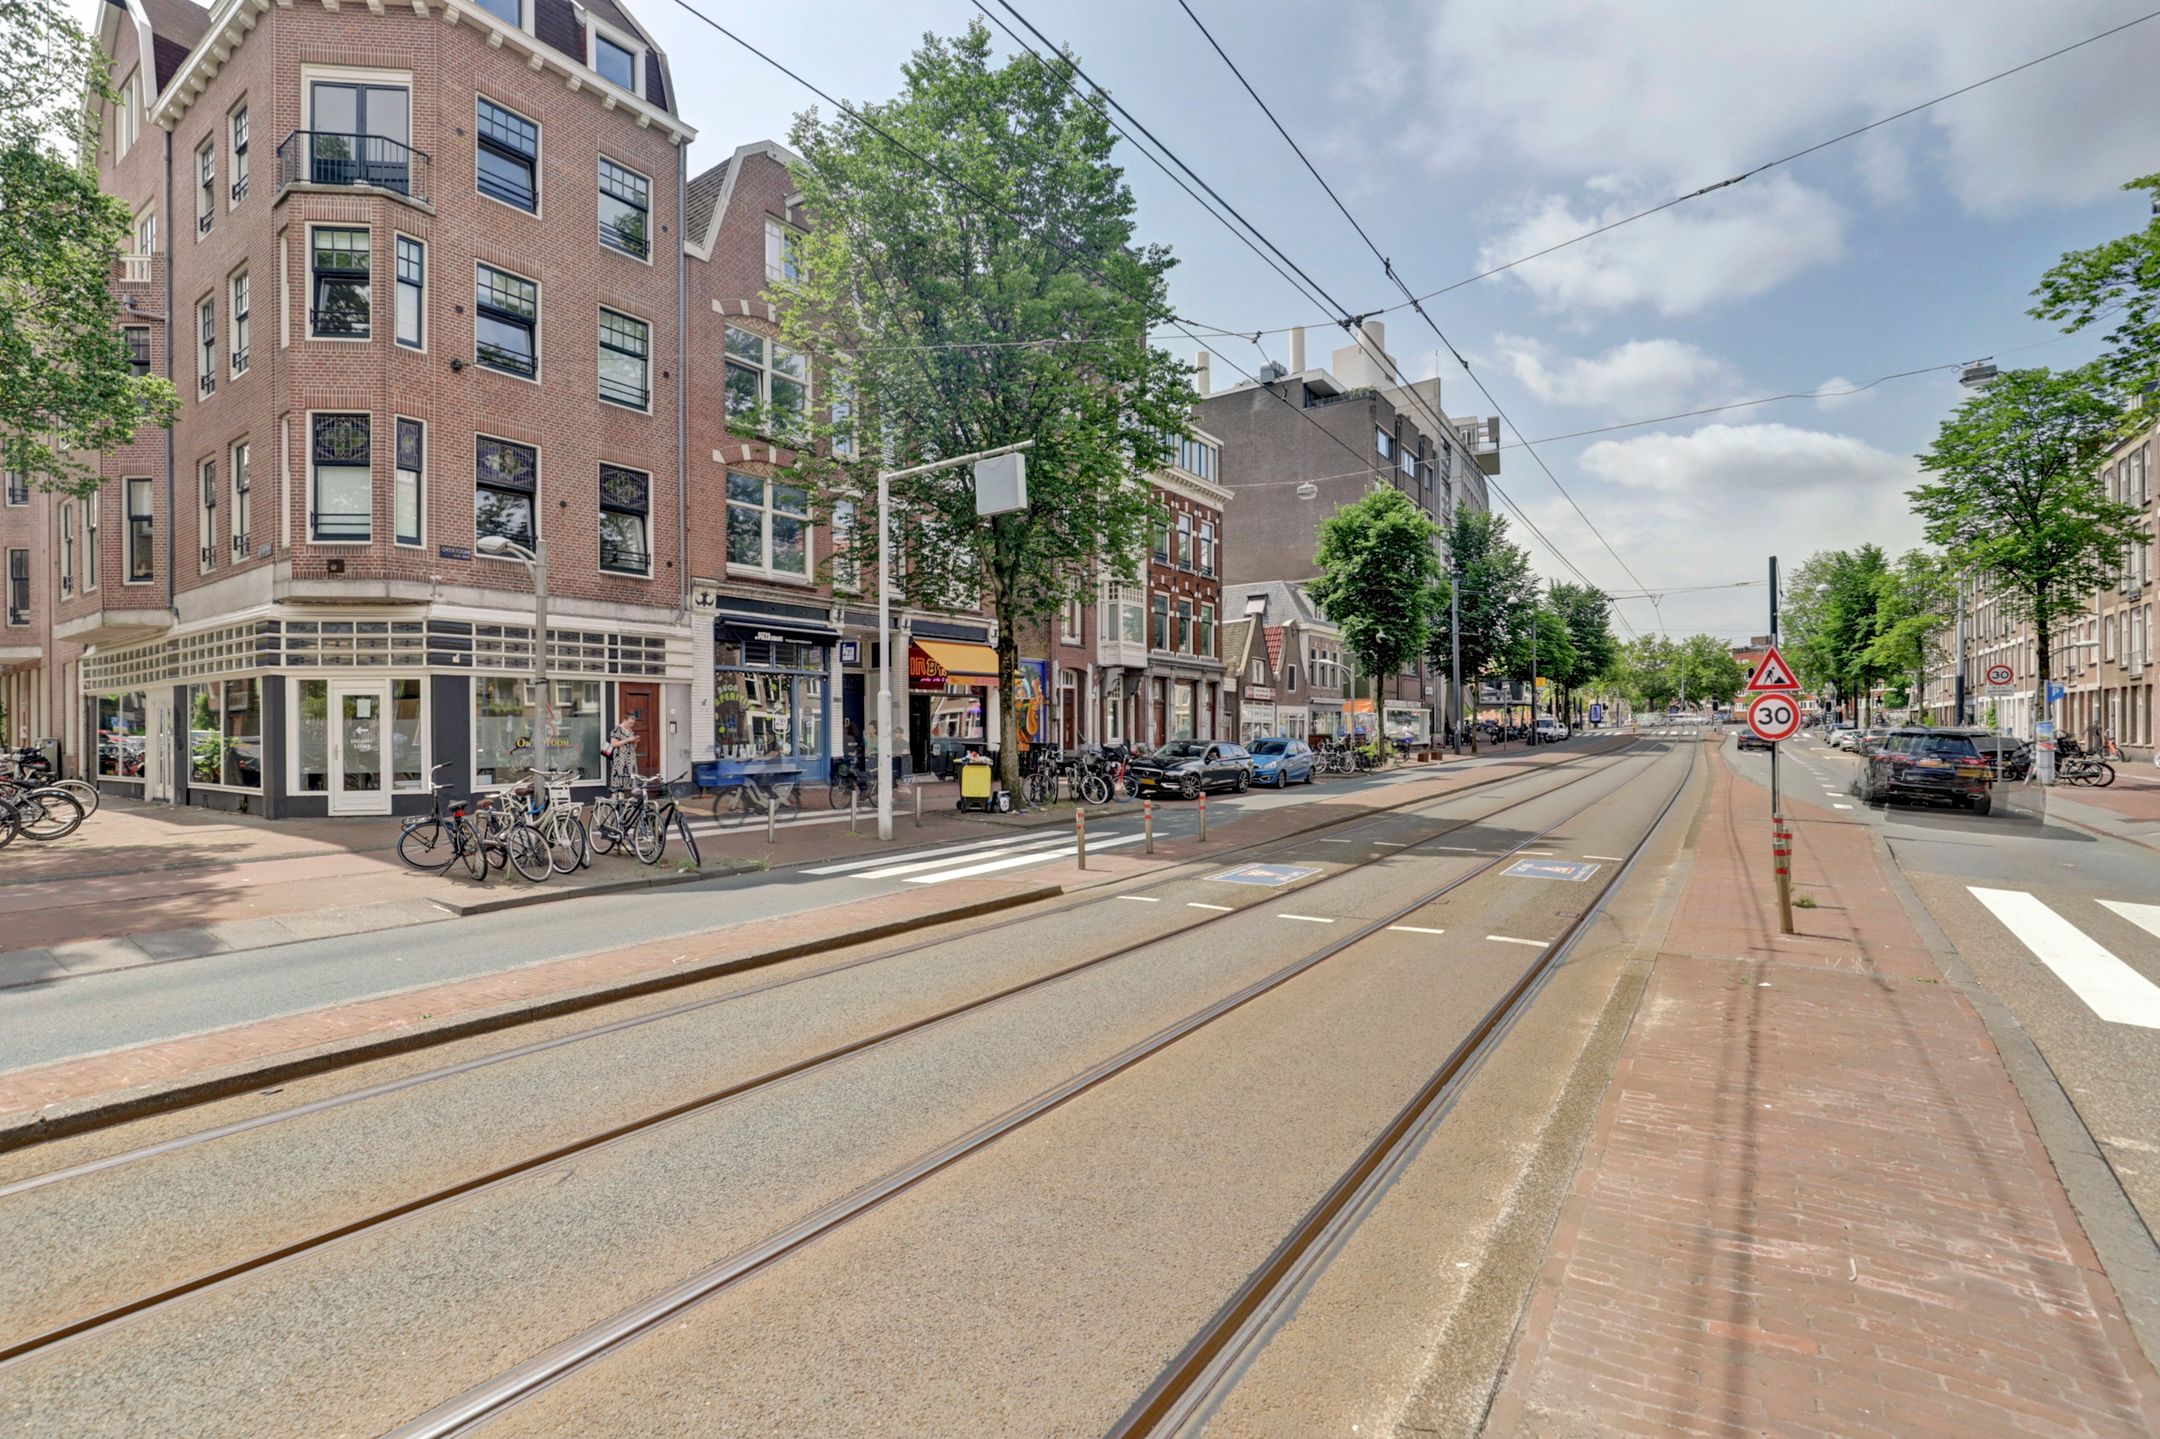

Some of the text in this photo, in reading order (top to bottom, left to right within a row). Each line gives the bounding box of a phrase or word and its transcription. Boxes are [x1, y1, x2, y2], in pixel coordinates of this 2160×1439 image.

[441, 546, 471, 555] OVERTOOM
[1991, 670, 2009, 680] 30
[2052, 687, 2060, 697] P
[1757, 706, 1792, 726] 30
